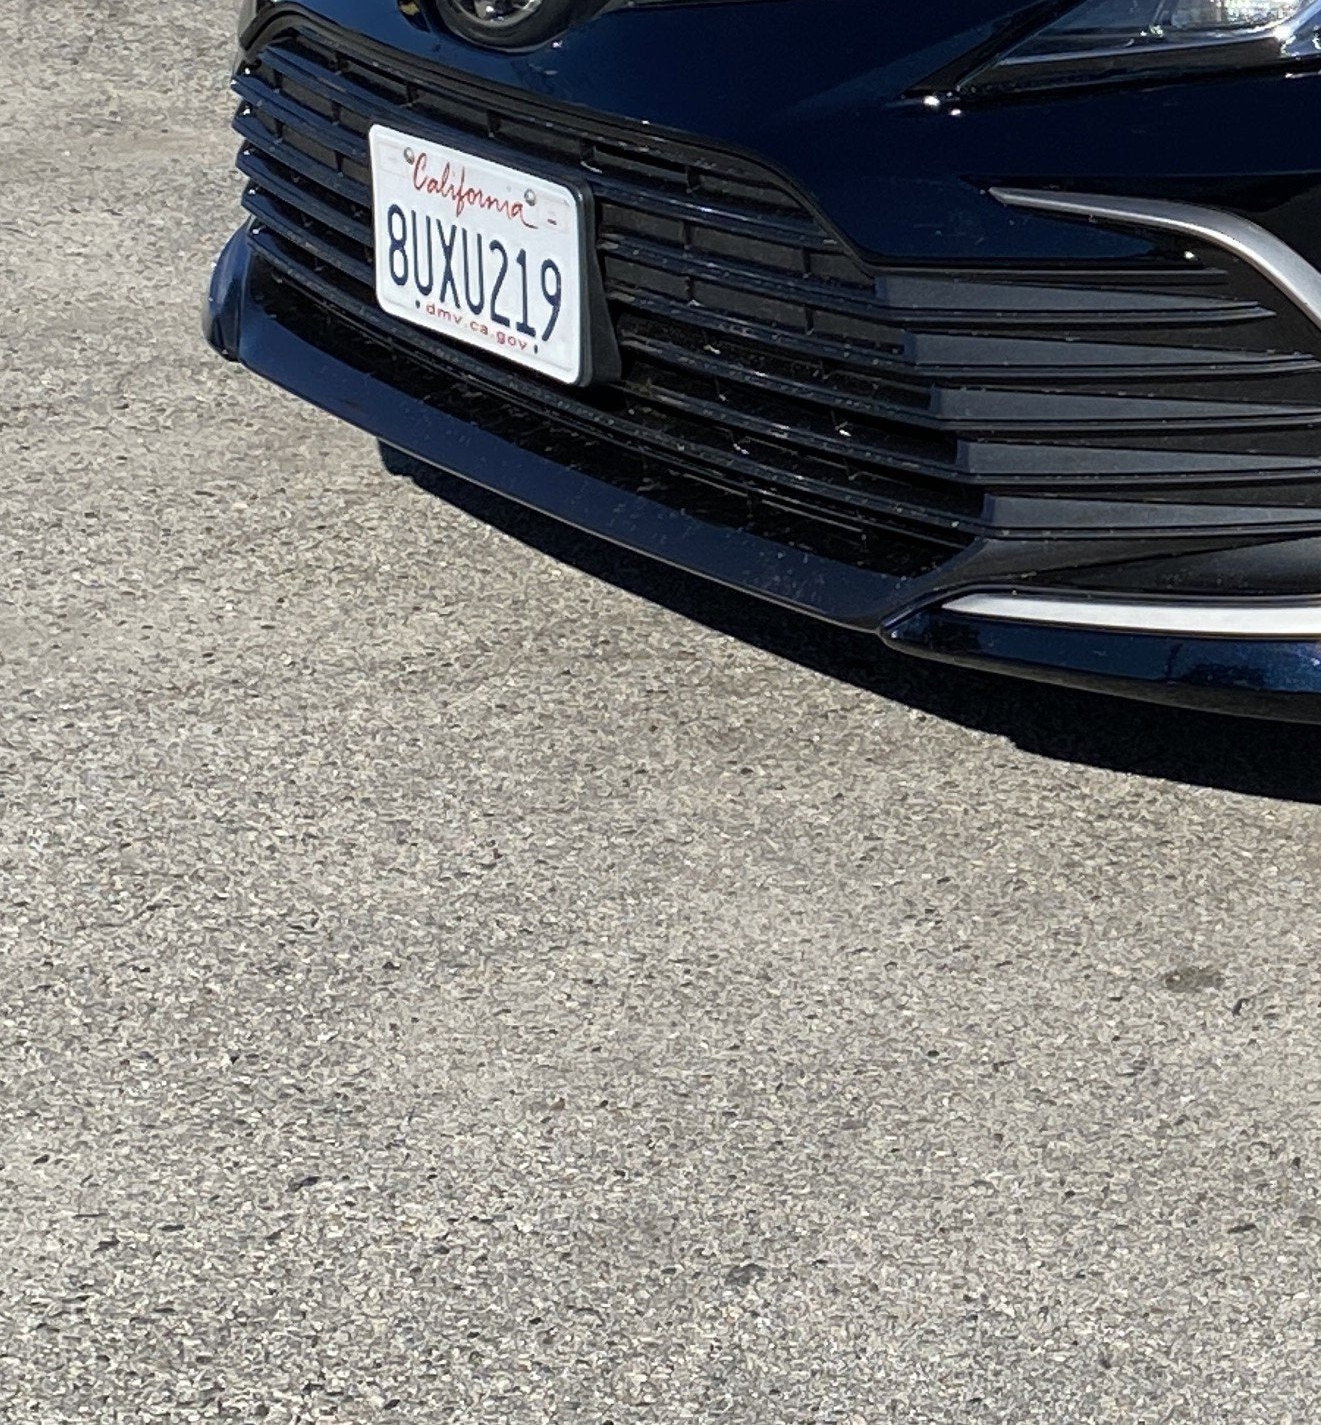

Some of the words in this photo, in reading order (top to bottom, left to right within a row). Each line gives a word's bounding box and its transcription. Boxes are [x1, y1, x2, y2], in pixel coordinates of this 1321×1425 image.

[413, 152, 539, 229] California
[387, 203, 562, 342] 8UXU219
[425, 302, 528, 351] dmv.ca.gov
